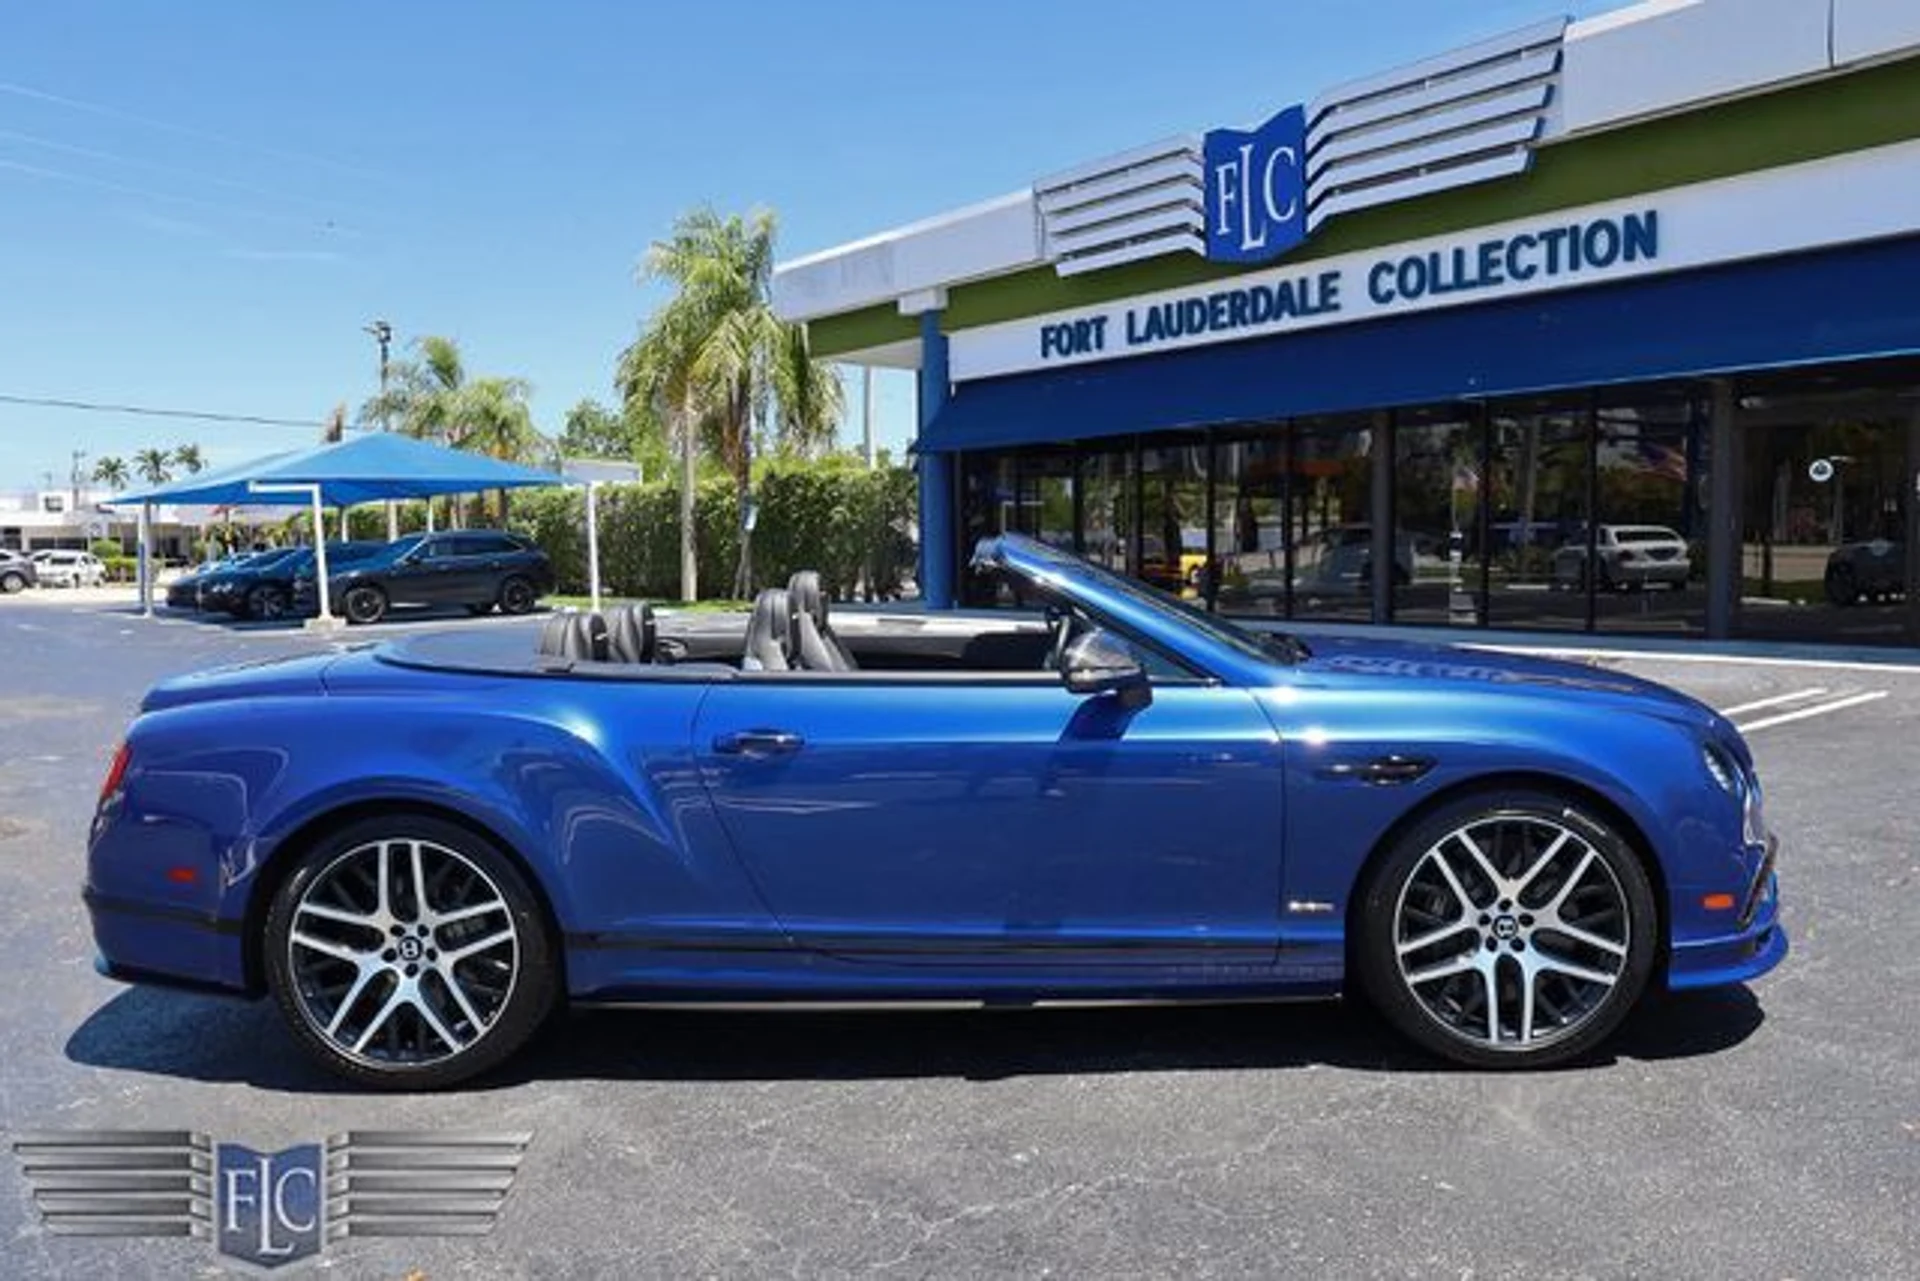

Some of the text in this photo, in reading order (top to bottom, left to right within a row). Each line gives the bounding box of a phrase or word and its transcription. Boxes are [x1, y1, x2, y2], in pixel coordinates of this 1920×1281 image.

[1216, 143, 1297, 251] FLC
[1040, 211, 1659, 359] FORT LAUDERDALE COLLECTION
